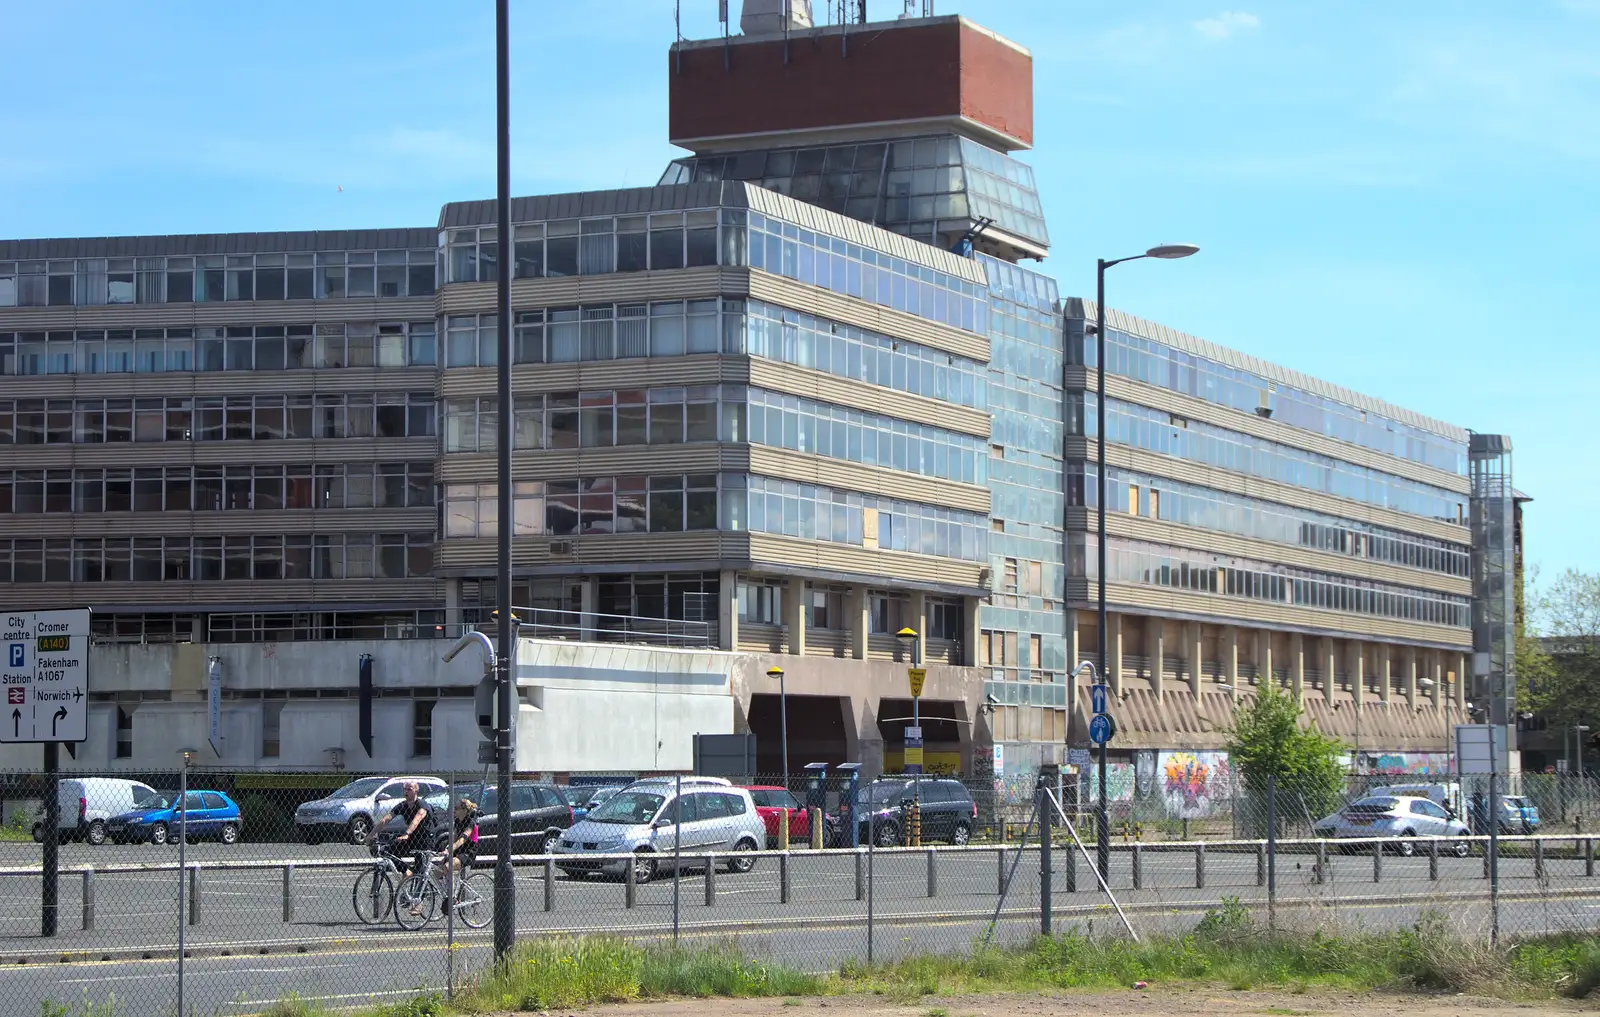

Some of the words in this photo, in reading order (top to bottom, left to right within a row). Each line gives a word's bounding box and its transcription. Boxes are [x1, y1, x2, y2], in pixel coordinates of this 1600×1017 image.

[9, 617, 25, 628] City
[38, 622, 69, 632] Cromer
[4, 630, 30, 640] centre
[38, 638, 69, 650] (A140)
[38, 658, 79, 668] Fakenham
[3, 674, 31, 684] Station
[38, 671, 65, 682] A1067
[37, 691, 70, 701] Norwich
